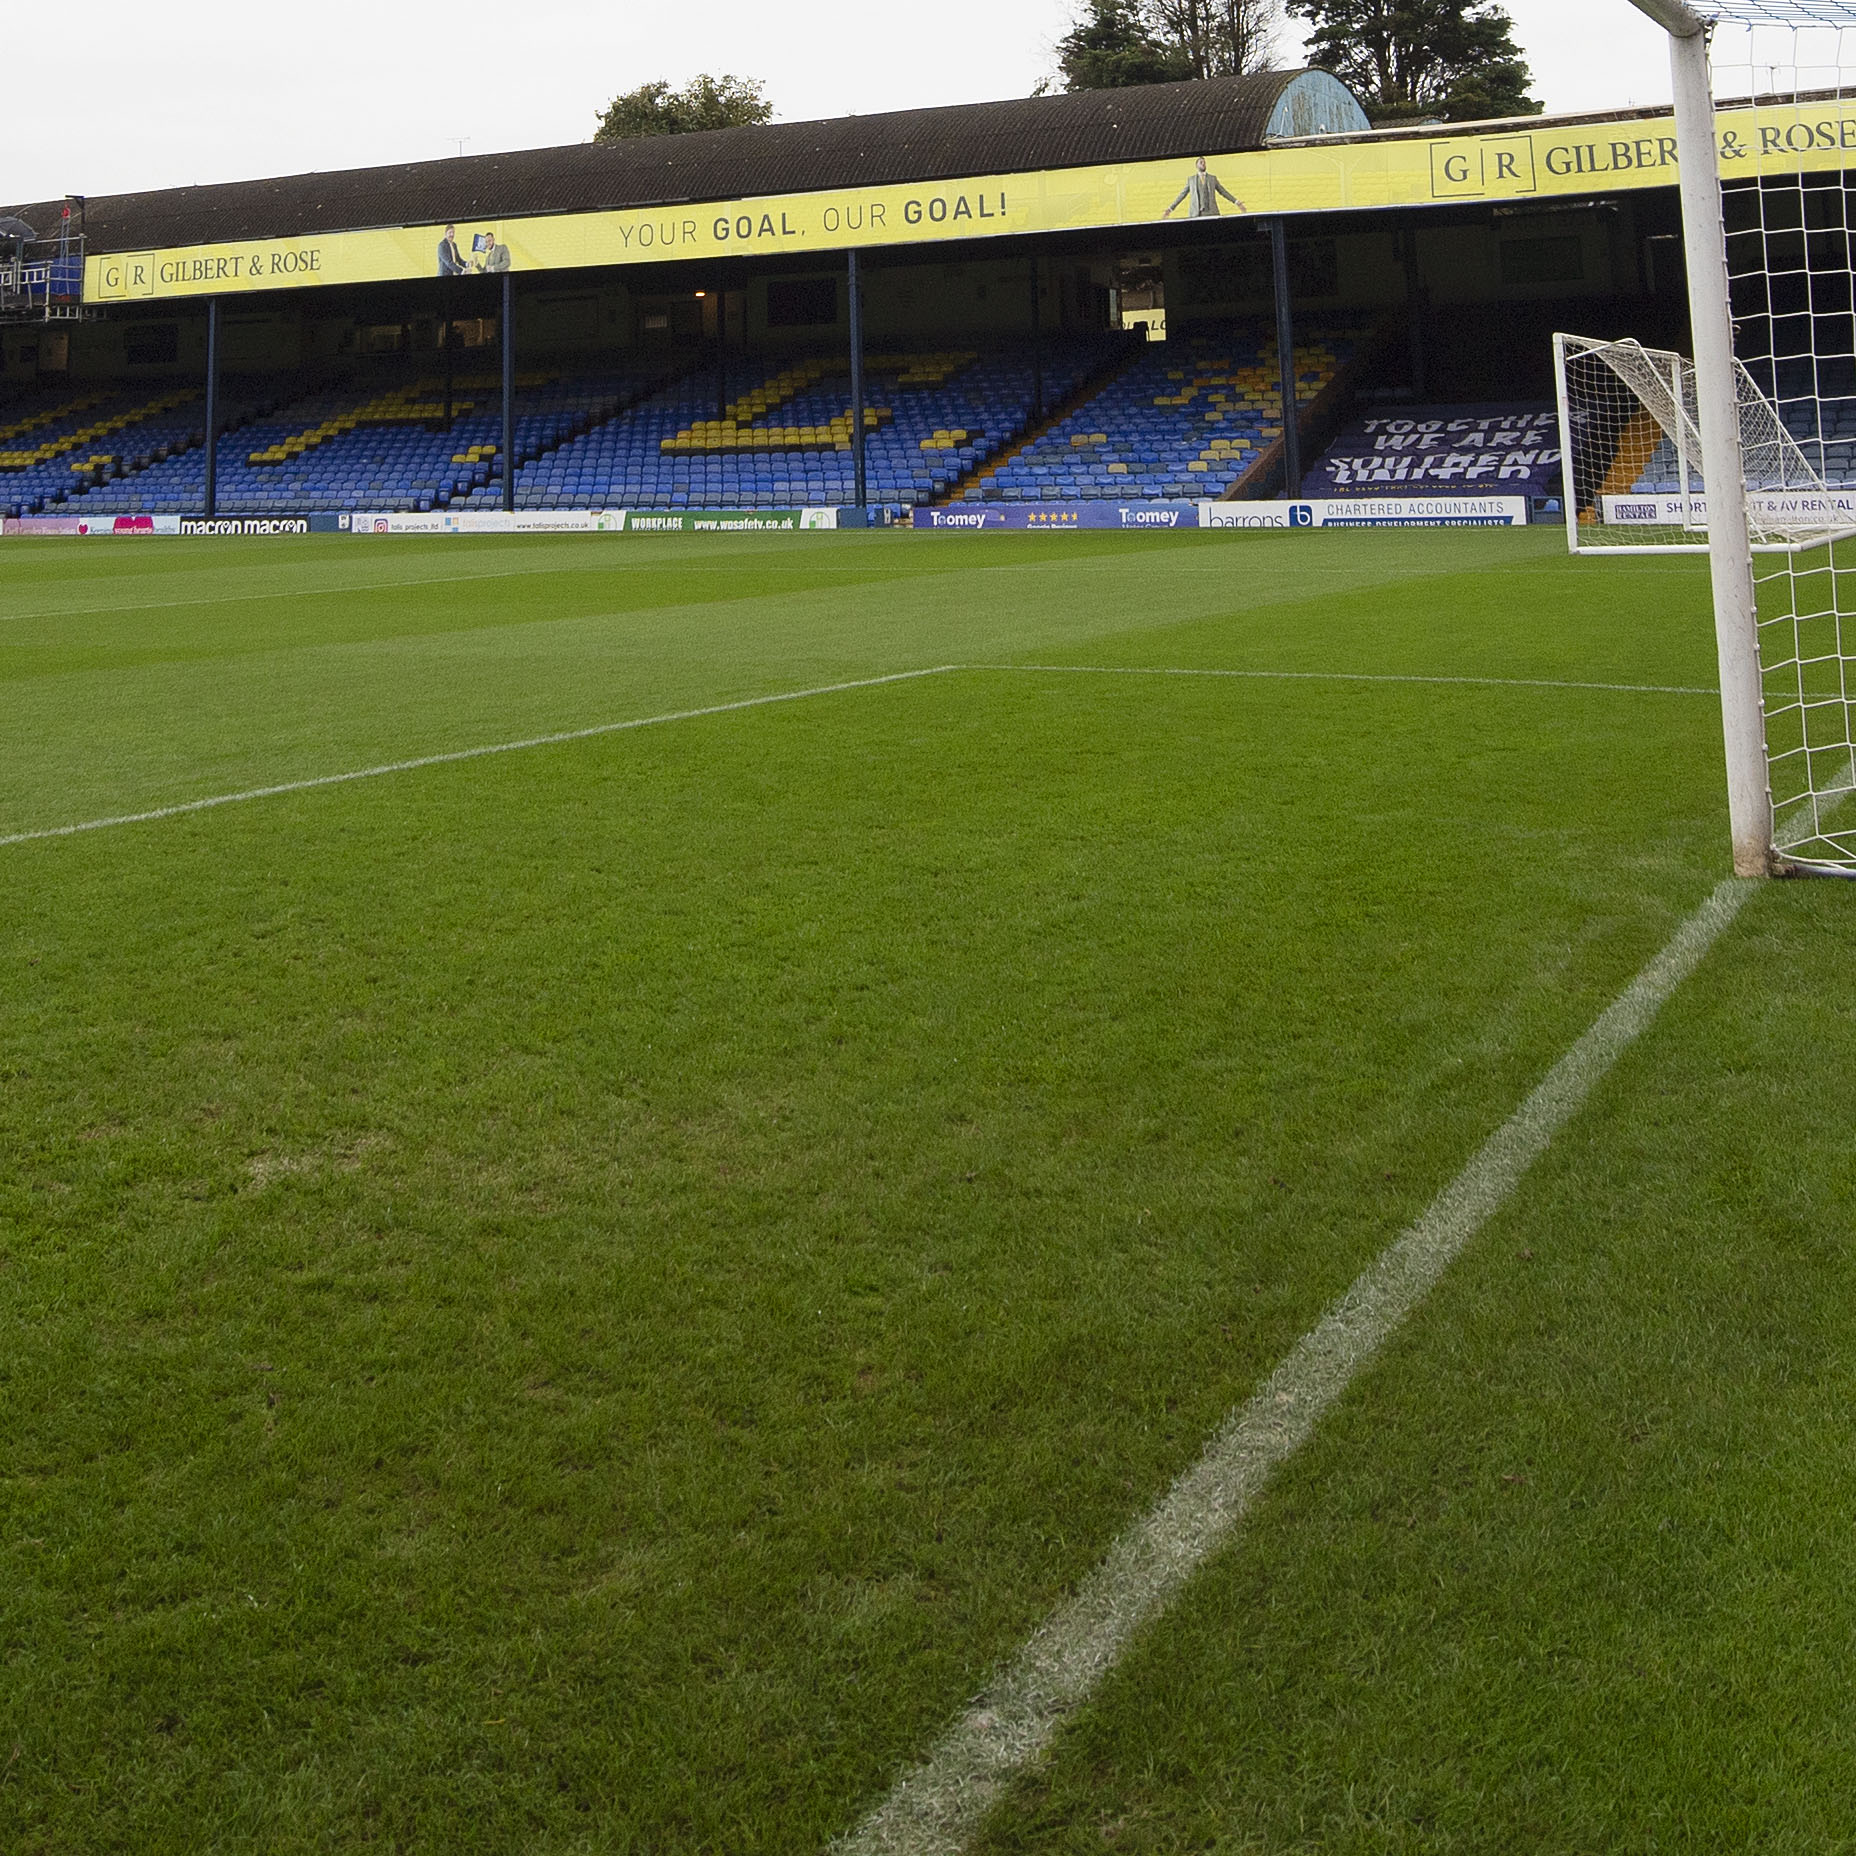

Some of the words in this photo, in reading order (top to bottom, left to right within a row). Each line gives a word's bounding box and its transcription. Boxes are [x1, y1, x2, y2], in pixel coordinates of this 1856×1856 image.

[1444, 154, 1470, 182] G
[1495, 151, 1522, 180] R
[1546, 136, 1679, 176] GILBER
[1719, 130, 1748, 161] &
[620, 221, 697, 249] YOUR
[713, 212, 806, 242] GOAL,
[823, 203, 887, 232] OUR
[904, 192, 1007, 224] GOAL!
[106, 267, 120, 287] G
[133, 265, 146, 285] R
[160, 255, 244, 283] GILBERT
[249, 254, 263, 275] &
[270, 249, 322, 274] ROSE
[1374, 432, 1444, 451] WE
[1452, 429, 1549, 448] ARE
[1327, 503, 1403, 516] CHARTERED
[1408, 501, 1504, 515] ACCOUNTANTS
[1767, 500, 1777, 511] &
[1802, 498, 1853, 511] RENTAL
[631, 517, 683, 530] WORKPLACE
[930, 511, 986, 528] Toomey
[1118, 507, 1179, 528] Toomey
[1209, 506, 1282, 527] barrons
[181, 520, 241, 535] macron
[244, 519, 307, 534] macron
